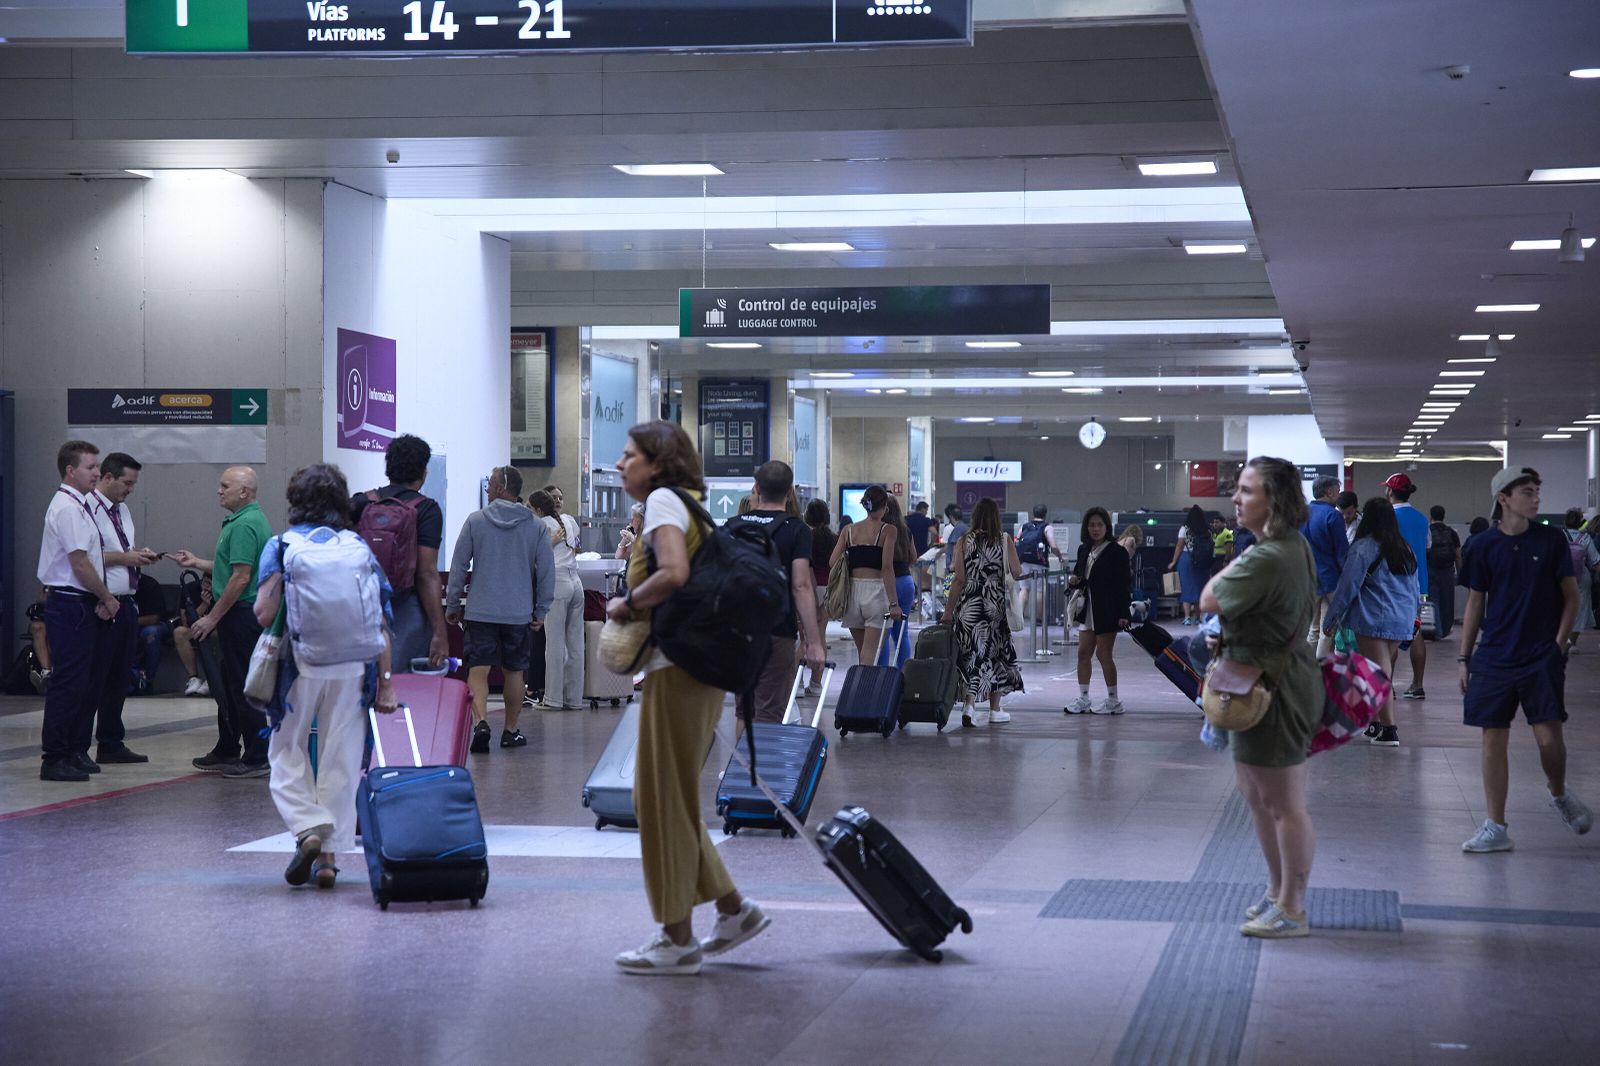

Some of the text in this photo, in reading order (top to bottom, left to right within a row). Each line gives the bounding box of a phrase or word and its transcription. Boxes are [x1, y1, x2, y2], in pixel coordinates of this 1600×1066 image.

[308, 0, 349, 21] Vías
[402, 0, 460, 41] 14
[518, 0, 571, 40] 21
[308, 28, 386, 41] PLATFORMS
[738, 297, 877, 313] Control de equipajes
[738, 318, 818, 328] LUGGAGE CONTROL
[127, 395, 203, 405] adif acerca
[604, 399, 624, 424] adif
[966, 463, 1009, 479] renfe
